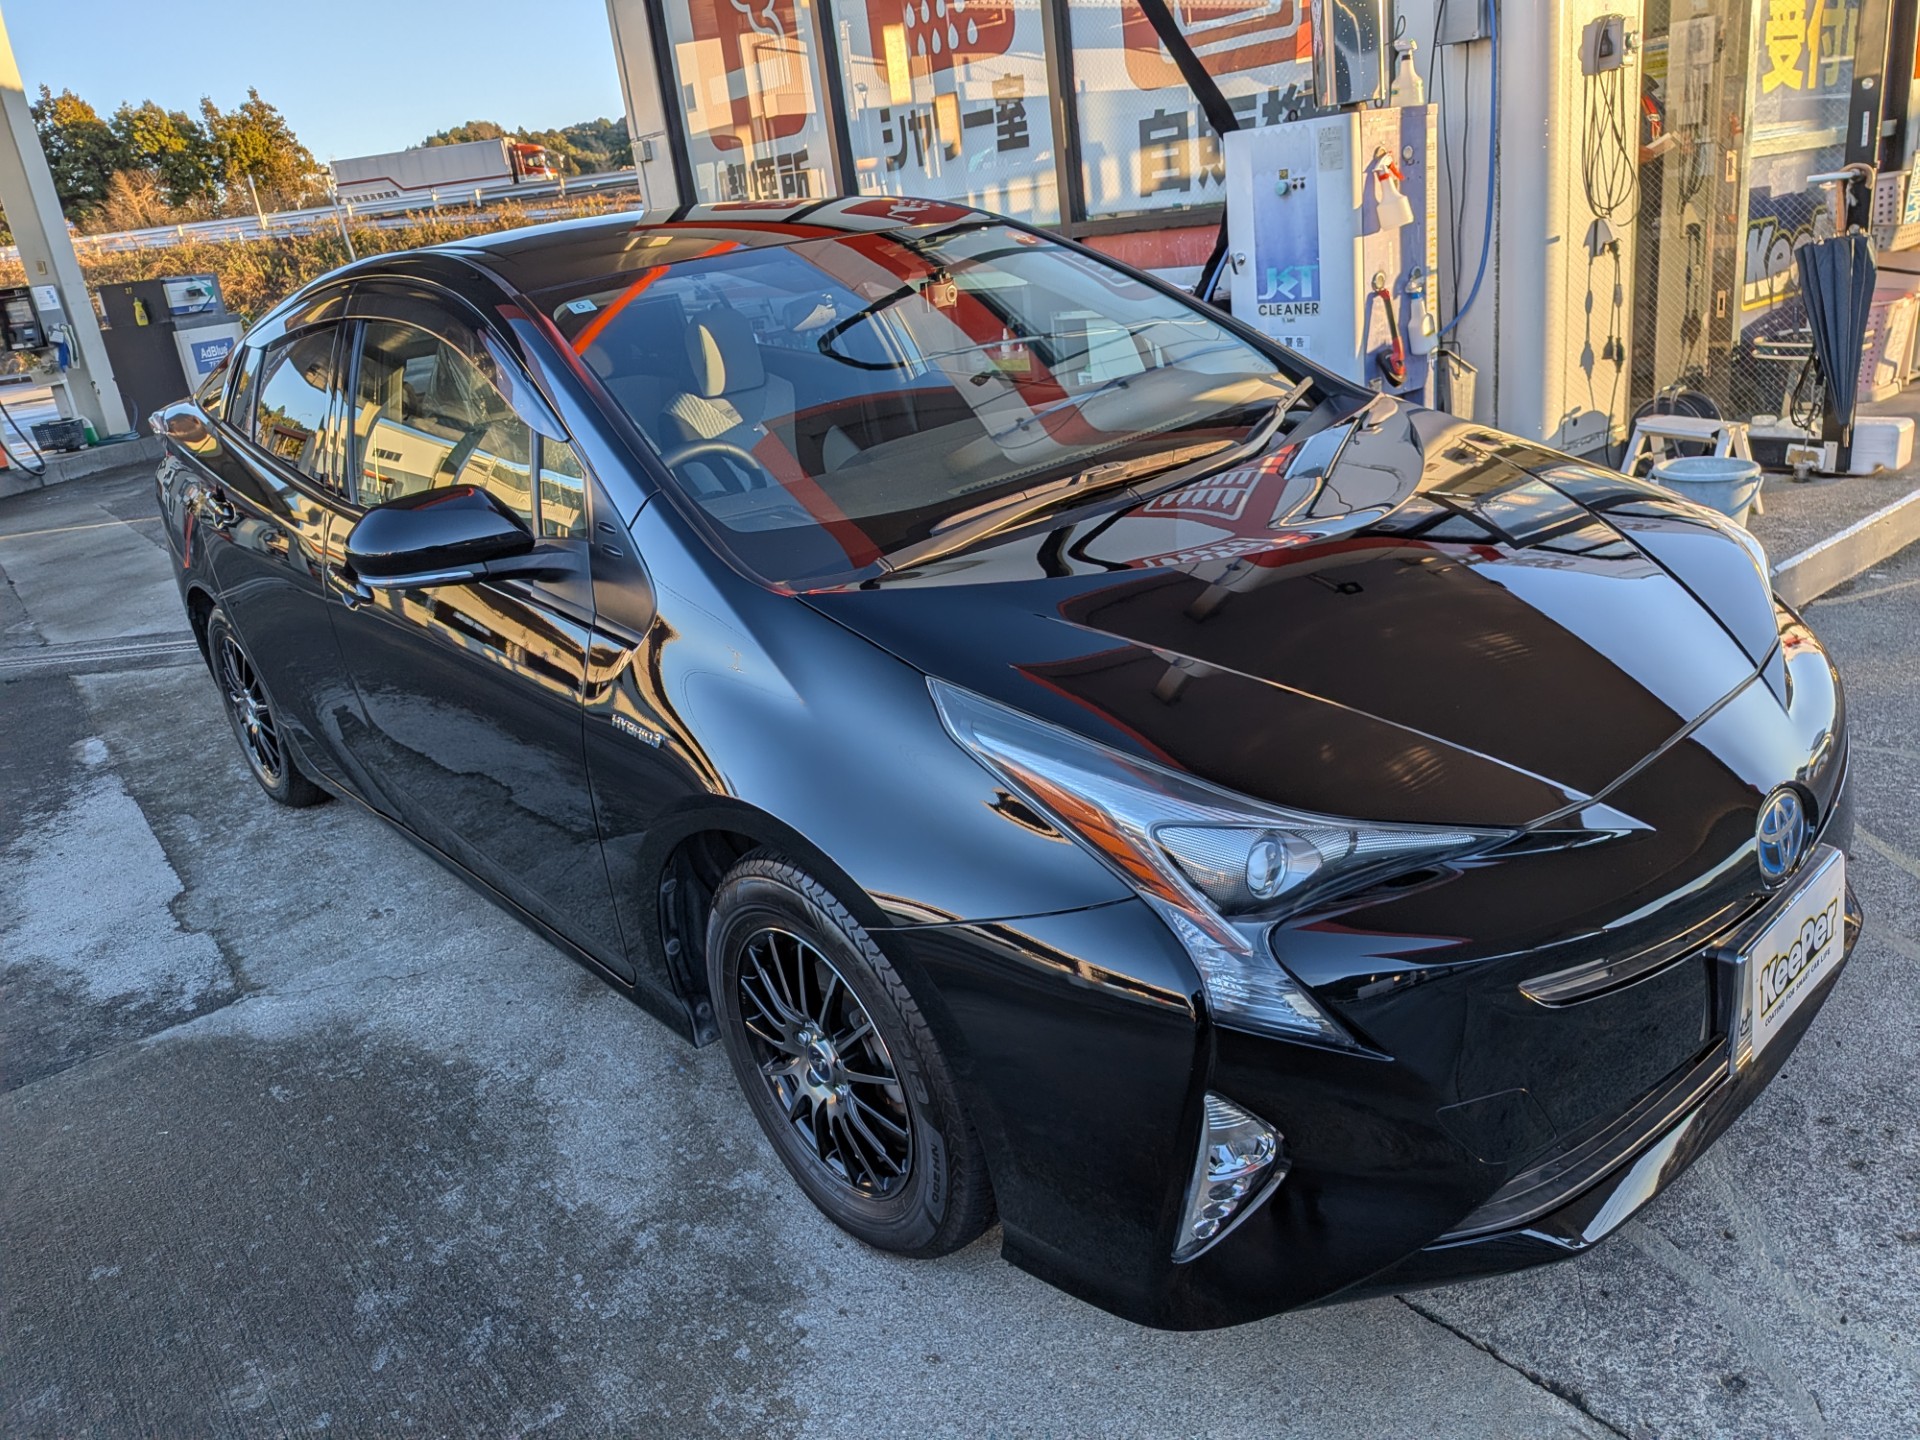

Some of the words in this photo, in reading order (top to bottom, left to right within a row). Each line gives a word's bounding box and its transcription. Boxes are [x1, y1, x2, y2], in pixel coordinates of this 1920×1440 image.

[1258, 264, 1319, 300] JET
[1258, 302, 1320, 316] CLEANER
[201, 346, 228, 359] AdBlue
[1761, 898, 1837, 1017] KeePer
[1785, 987, 1795, 1003] FOR
[1795, 971, 1811, 992] SMART
[1811, 960, 1820, 974] CAR
